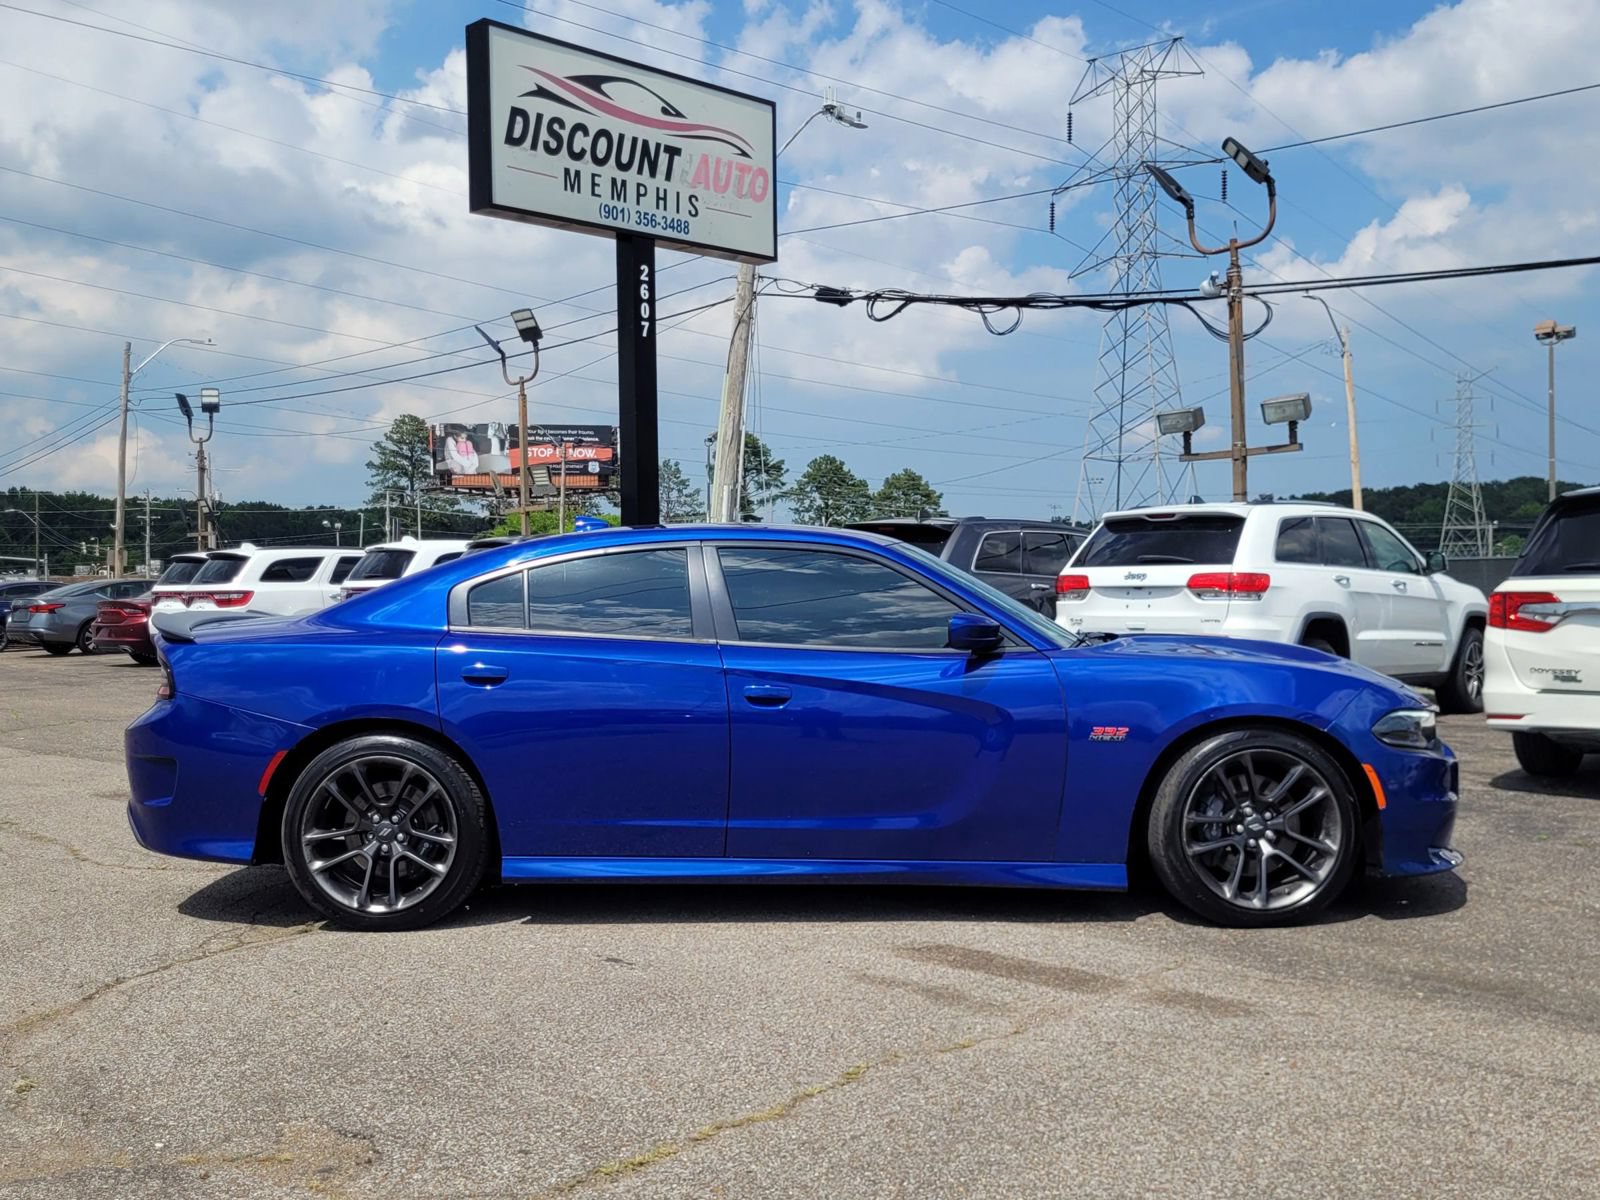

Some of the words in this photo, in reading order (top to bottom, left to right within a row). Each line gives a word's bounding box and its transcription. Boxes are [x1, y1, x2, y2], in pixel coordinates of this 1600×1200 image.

[504, 106, 682, 182] DISCOUNT
[690, 154, 769, 203] AUTO
[564, 167, 699, 217] MEMPHIS
[599, 202, 631, 224] (901)
[635, 210, 690, 235] 356-3488
[640, 264, 650, 337] 2607
[528, 448, 553, 458] STOP
[569, 448, 596, 458] NOW.
[1091, 726, 1129, 736] 392
